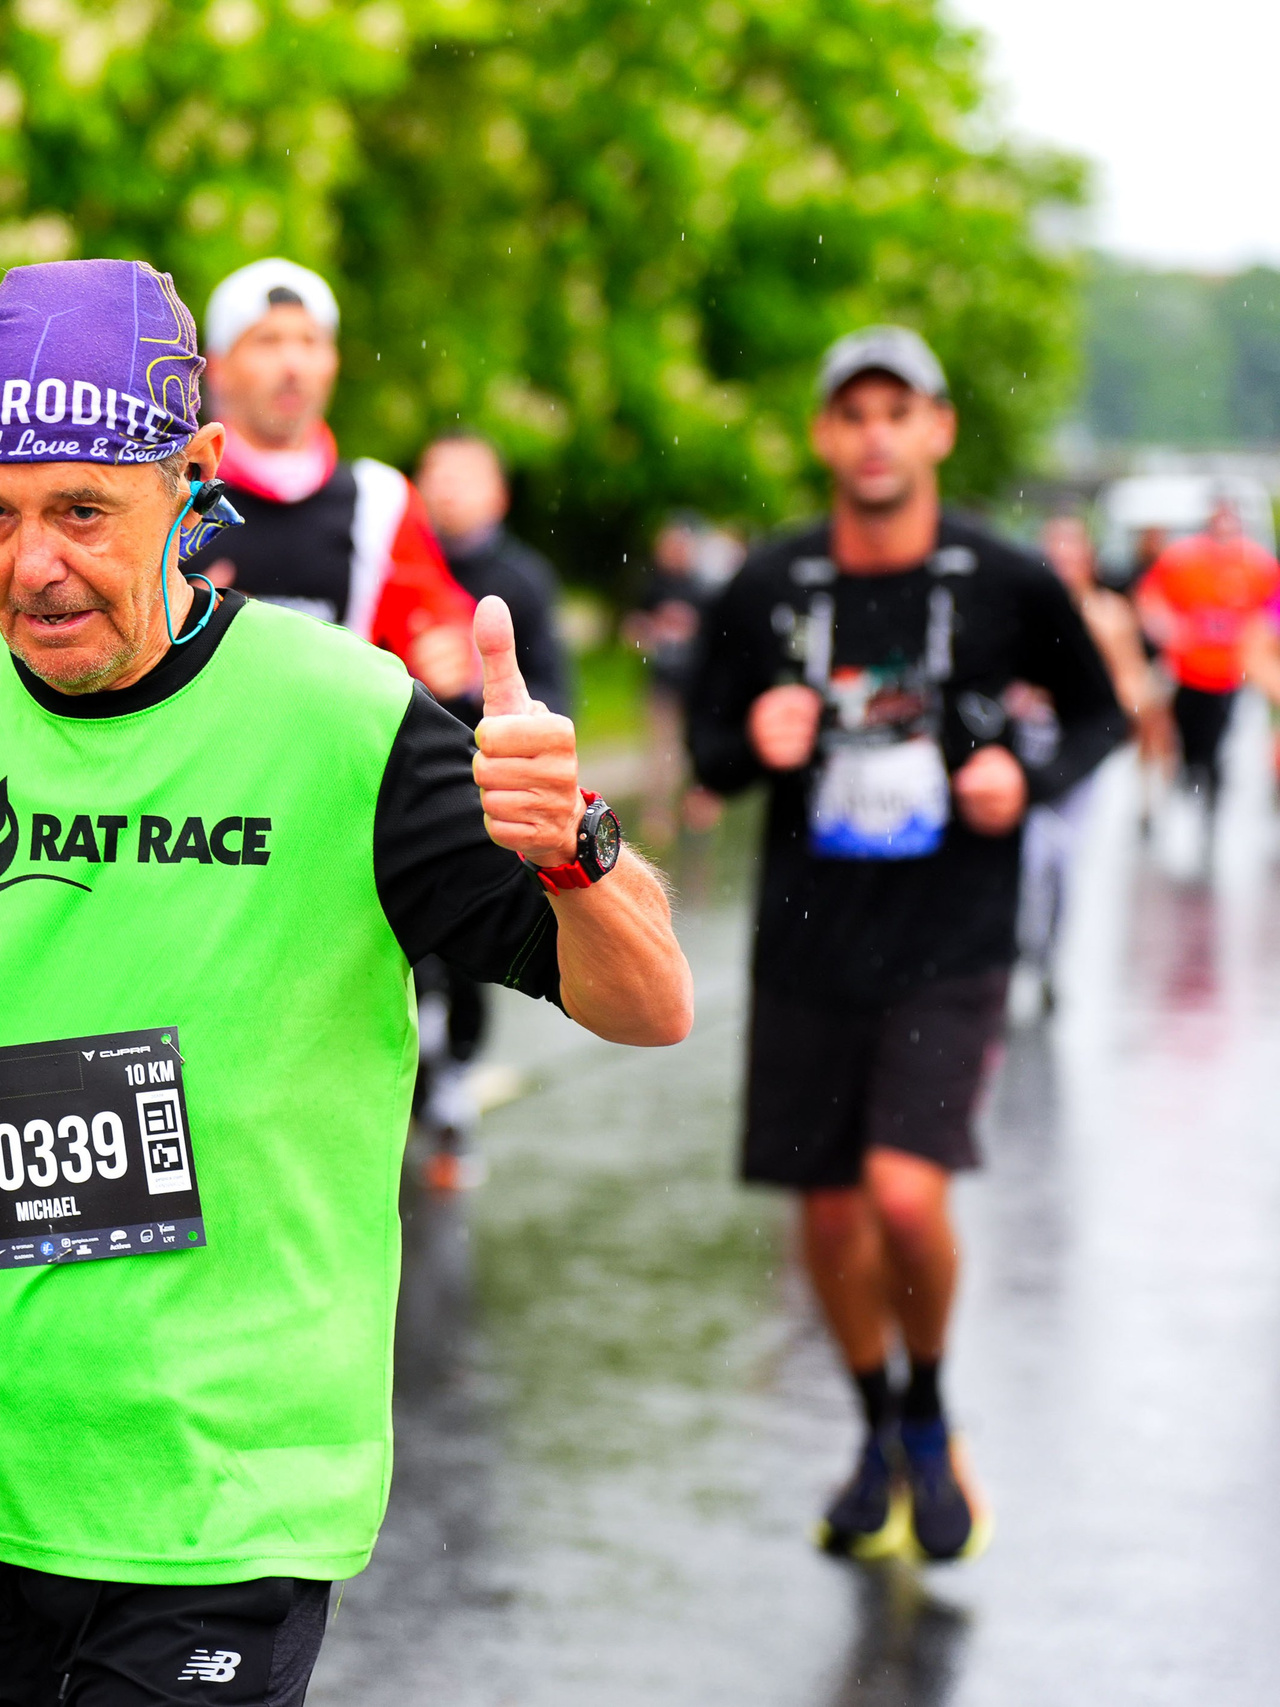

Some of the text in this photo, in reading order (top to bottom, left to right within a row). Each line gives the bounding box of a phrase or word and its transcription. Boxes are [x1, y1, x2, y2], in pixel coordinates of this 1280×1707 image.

[8, 428, 81, 457] Love
[90, 437, 109, 459] &
[29, 813, 273, 866] RAT RACE
[99, 1045, 152, 1058] CUPRA
[124, 1060, 176, 1086] 10 KM
[15, 1196, 82, 1222] MICHAEL
